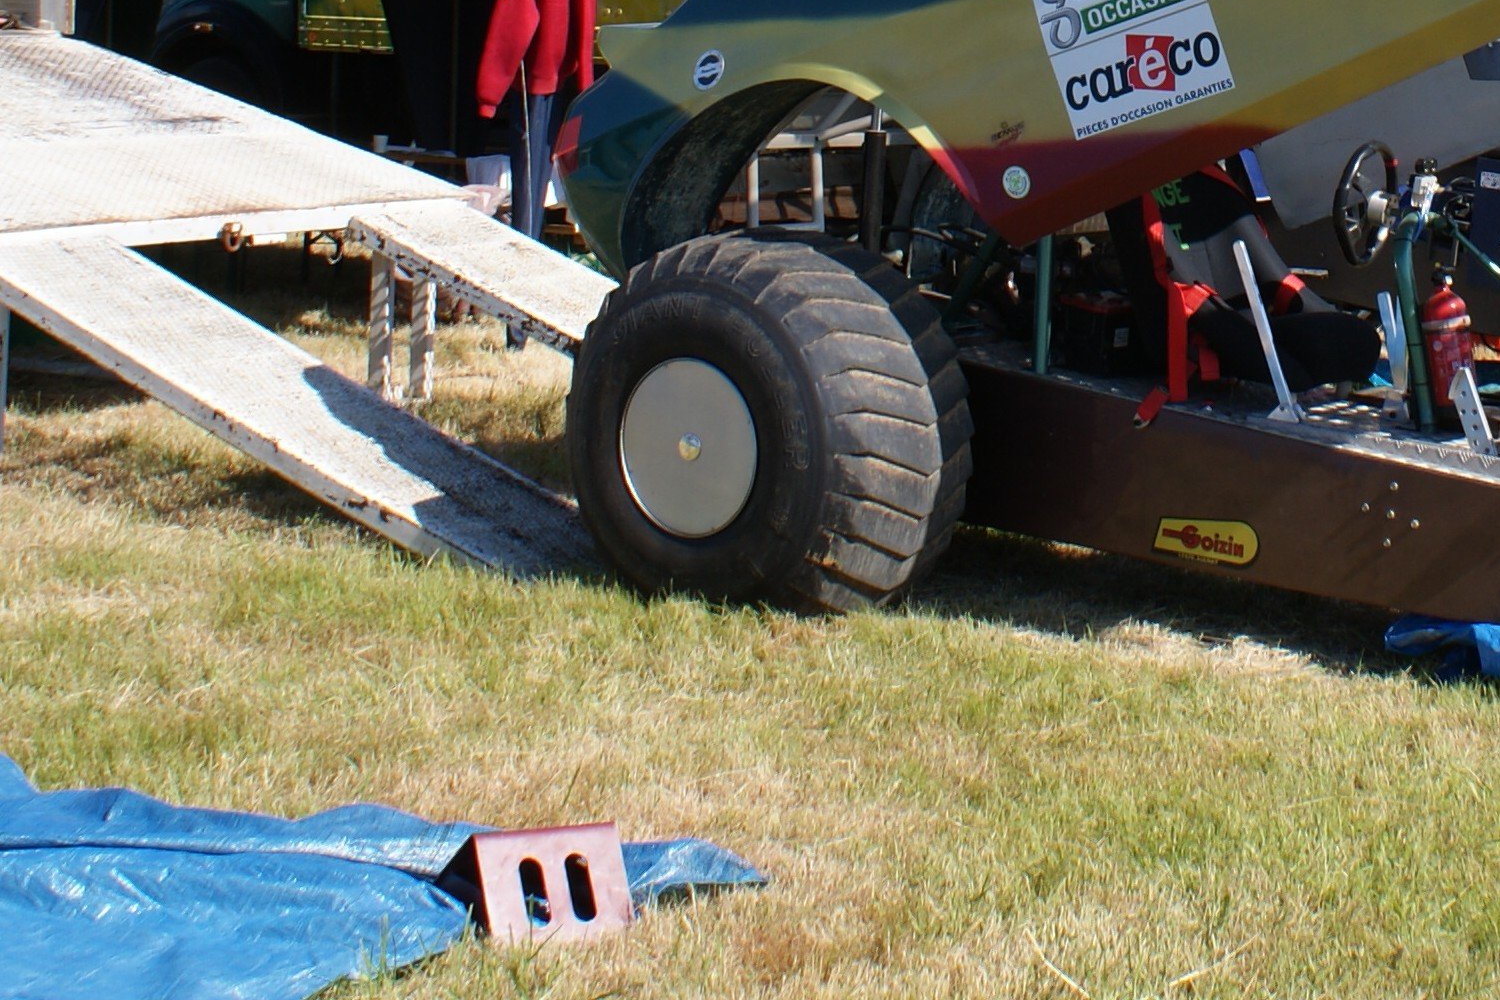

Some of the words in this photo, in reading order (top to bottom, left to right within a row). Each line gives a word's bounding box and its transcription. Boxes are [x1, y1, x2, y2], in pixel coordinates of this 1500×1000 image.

[1065, 31, 1221, 112] caréco
[1076, 119, 1109, 138] PIECES
[1111, 99, 1173, 127] D'OCCASION
[1175, 78, 1234, 105] GARANTIES
